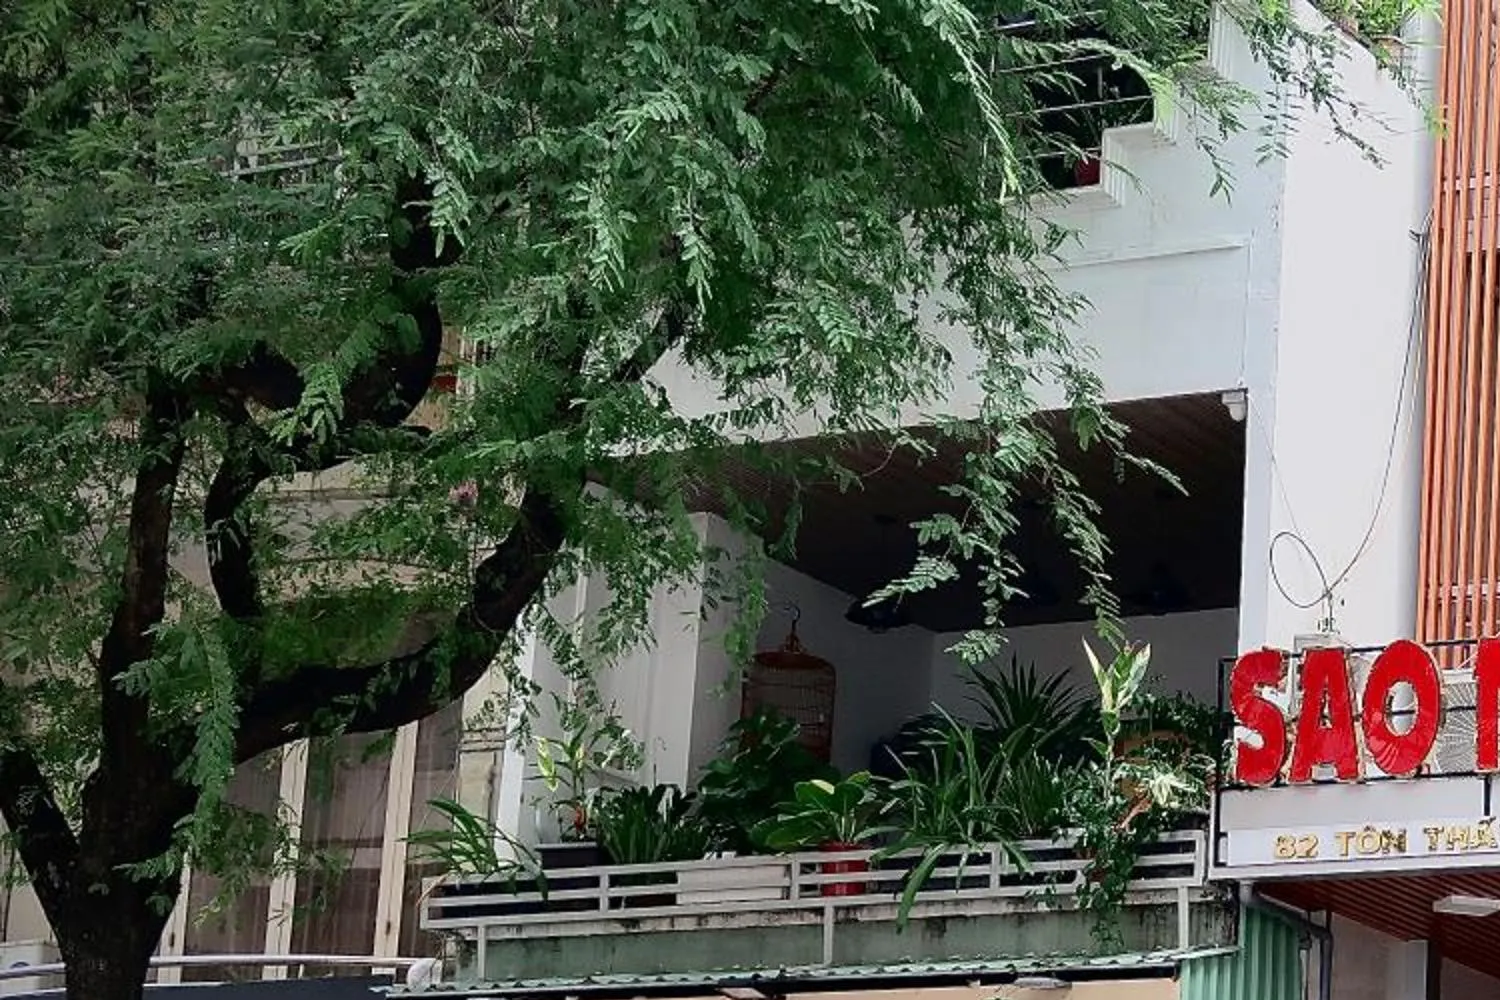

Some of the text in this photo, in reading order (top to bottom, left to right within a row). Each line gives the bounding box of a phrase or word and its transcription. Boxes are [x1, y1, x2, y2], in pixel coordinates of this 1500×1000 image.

[1231, 639, 1443, 787] SAO
[1274, 833, 1320, 859] 82
[1336, 824, 1407, 856] TÔN
